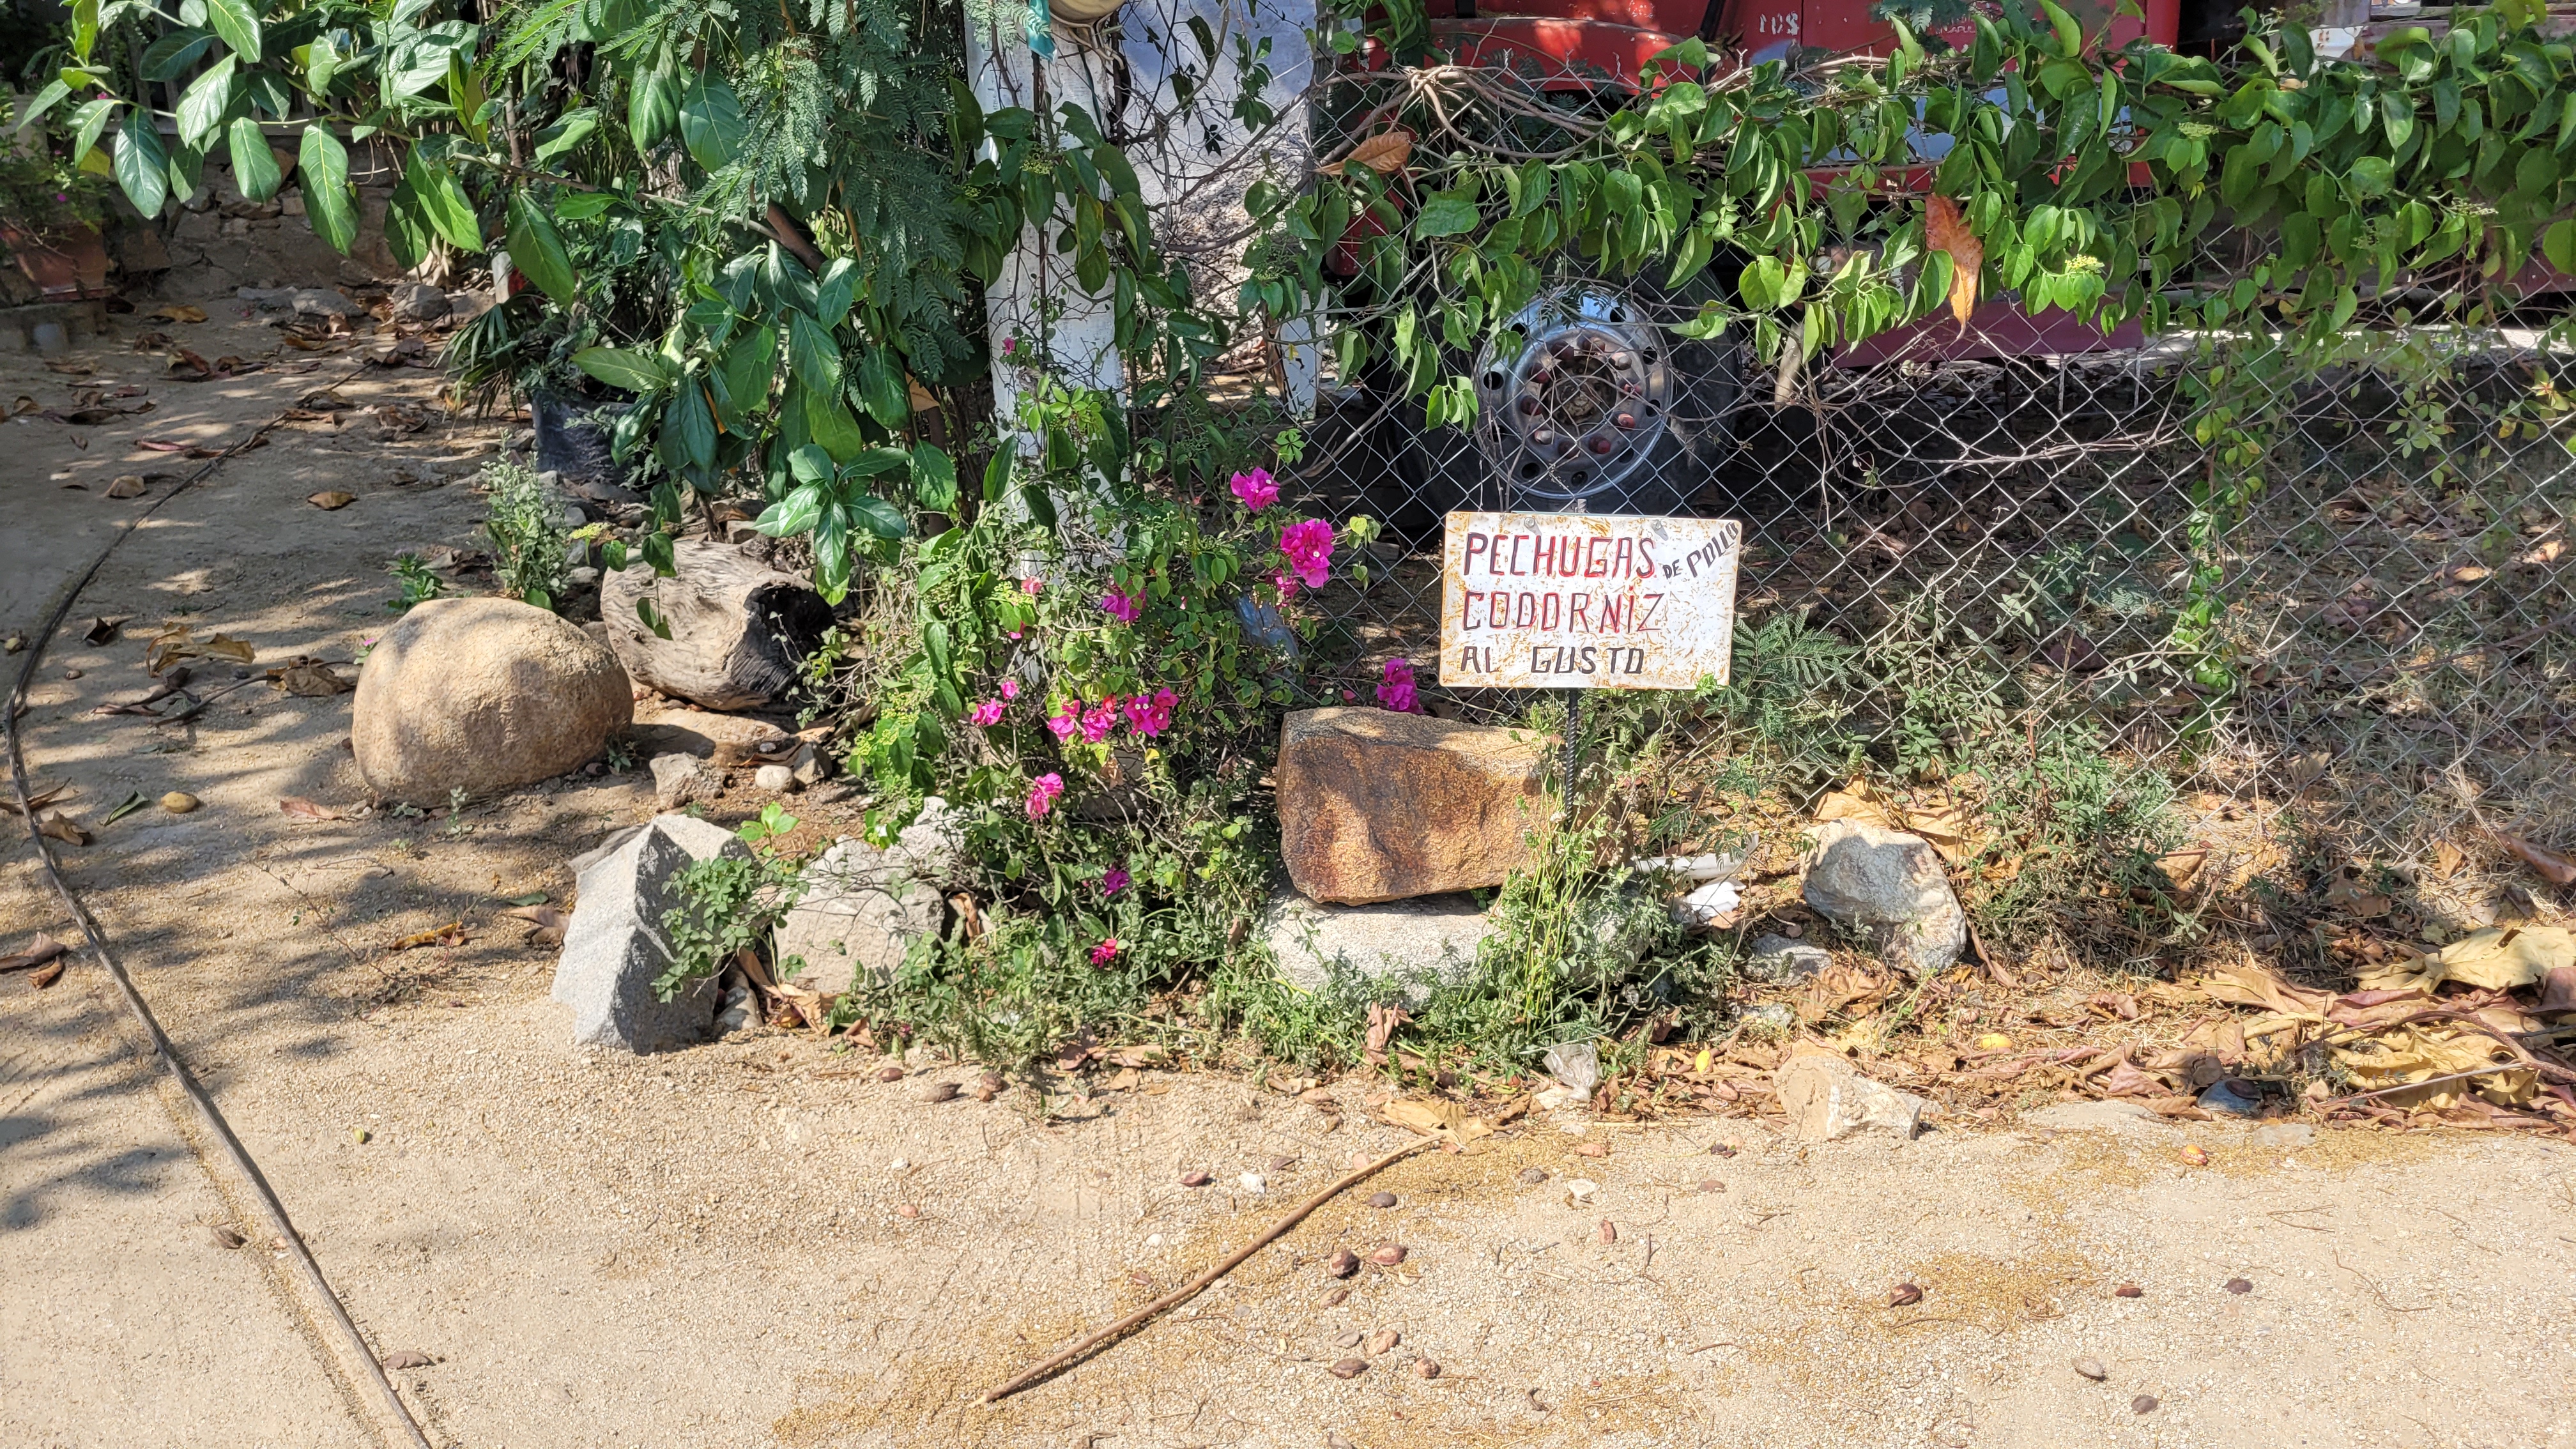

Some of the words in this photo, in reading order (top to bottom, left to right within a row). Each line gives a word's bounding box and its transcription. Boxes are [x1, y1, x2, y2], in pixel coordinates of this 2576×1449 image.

[1464, 532, 1657, 578] PECHUGAS
[1662, 559, 1682, 579] DE
[1687, 522, 1738, 578] POLLO
[1460, 646, 1499, 673] AL
[1531, 646, 1644, 675] GUSTO
